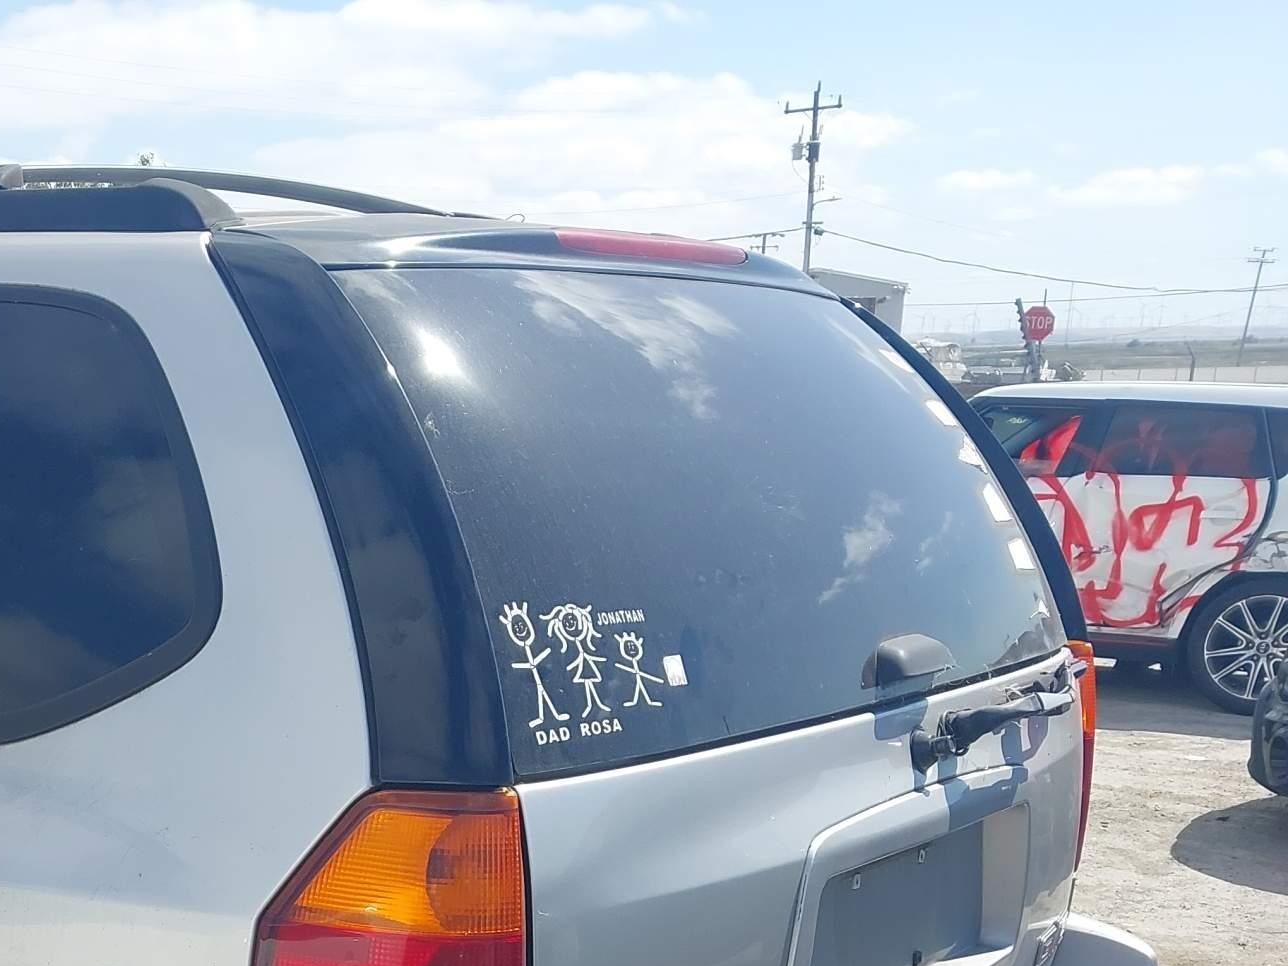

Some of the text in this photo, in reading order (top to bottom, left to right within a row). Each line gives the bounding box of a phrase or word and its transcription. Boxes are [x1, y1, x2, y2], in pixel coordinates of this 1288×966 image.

[1024, 316, 1053, 329] STOP
[597, 609, 645, 626] JONATHAN
[535, 719, 623, 745] DAD ROSA
